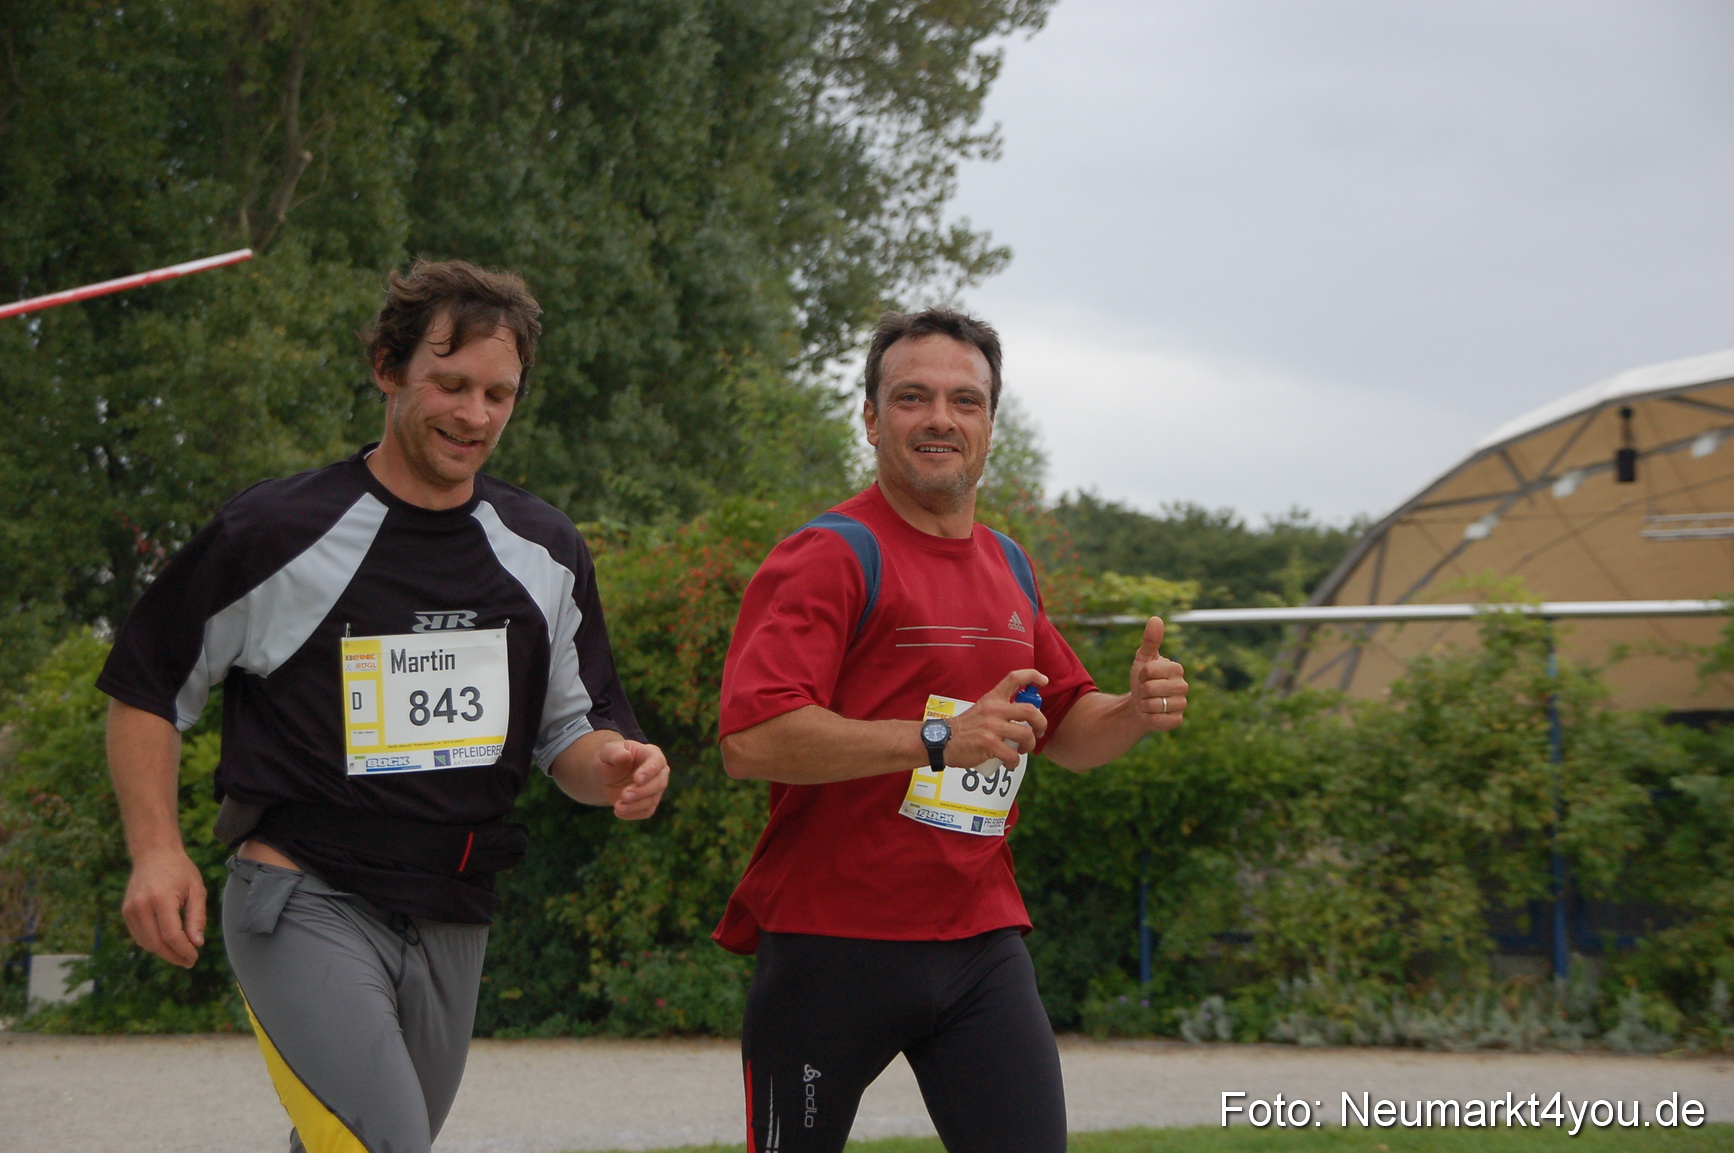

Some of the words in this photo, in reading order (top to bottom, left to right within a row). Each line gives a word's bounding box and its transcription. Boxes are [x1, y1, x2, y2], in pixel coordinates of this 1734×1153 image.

[390, 648, 456, 674] Martin
[352, 691, 362, 710] D
[408, 685, 484, 726] 843
[366, 755, 410, 768] BOCK
[804, 1083, 818, 1129] odlo
